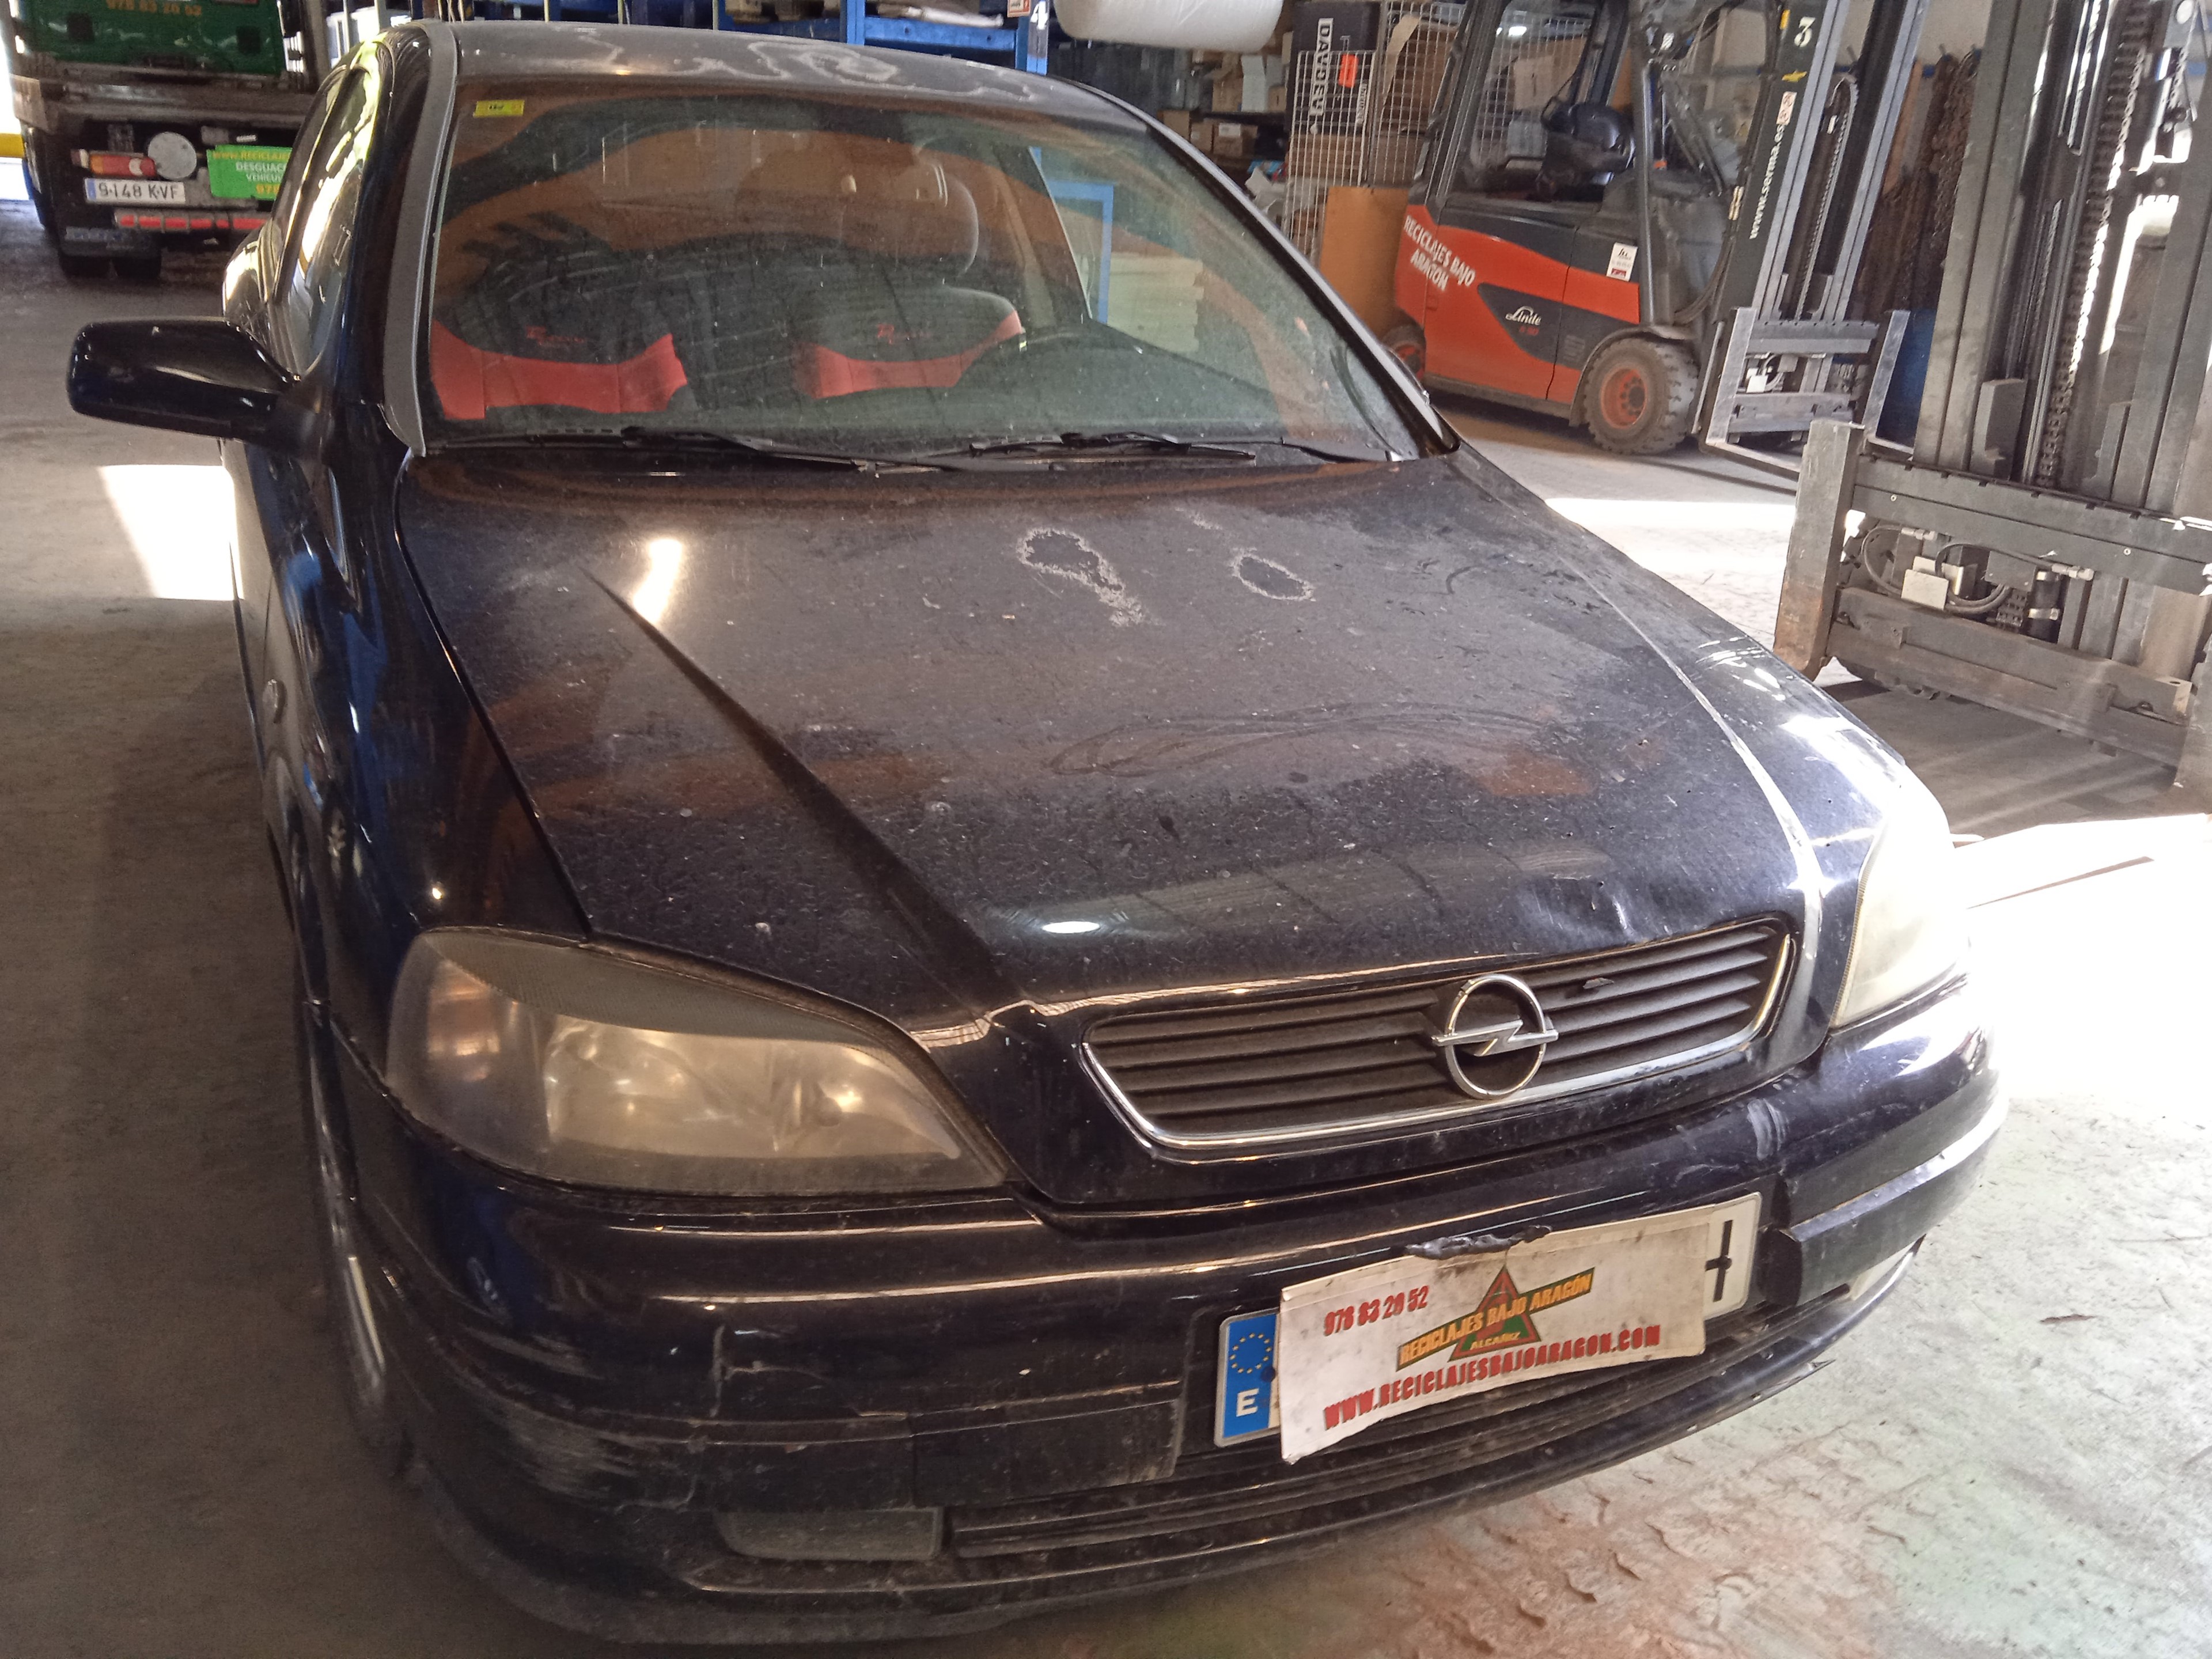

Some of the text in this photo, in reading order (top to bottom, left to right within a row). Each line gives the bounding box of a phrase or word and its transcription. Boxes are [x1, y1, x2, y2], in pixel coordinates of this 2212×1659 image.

[1404, 215, 1475, 287] RECICLAJES BAJO
[1410, 248, 1449, 291] ARAGON
[1505, 306, 1541, 325] Linde
[1324, 1285, 1429, 1336] 978 83 20 52
[1400, 1273, 1592, 1364] RECICLAJES BAJO ARAGÓN
[1236, 1388, 1260, 1418] E
[1323, 1324, 1660, 1431] WWW.RECICLAJESBAJOARAGON.COM
